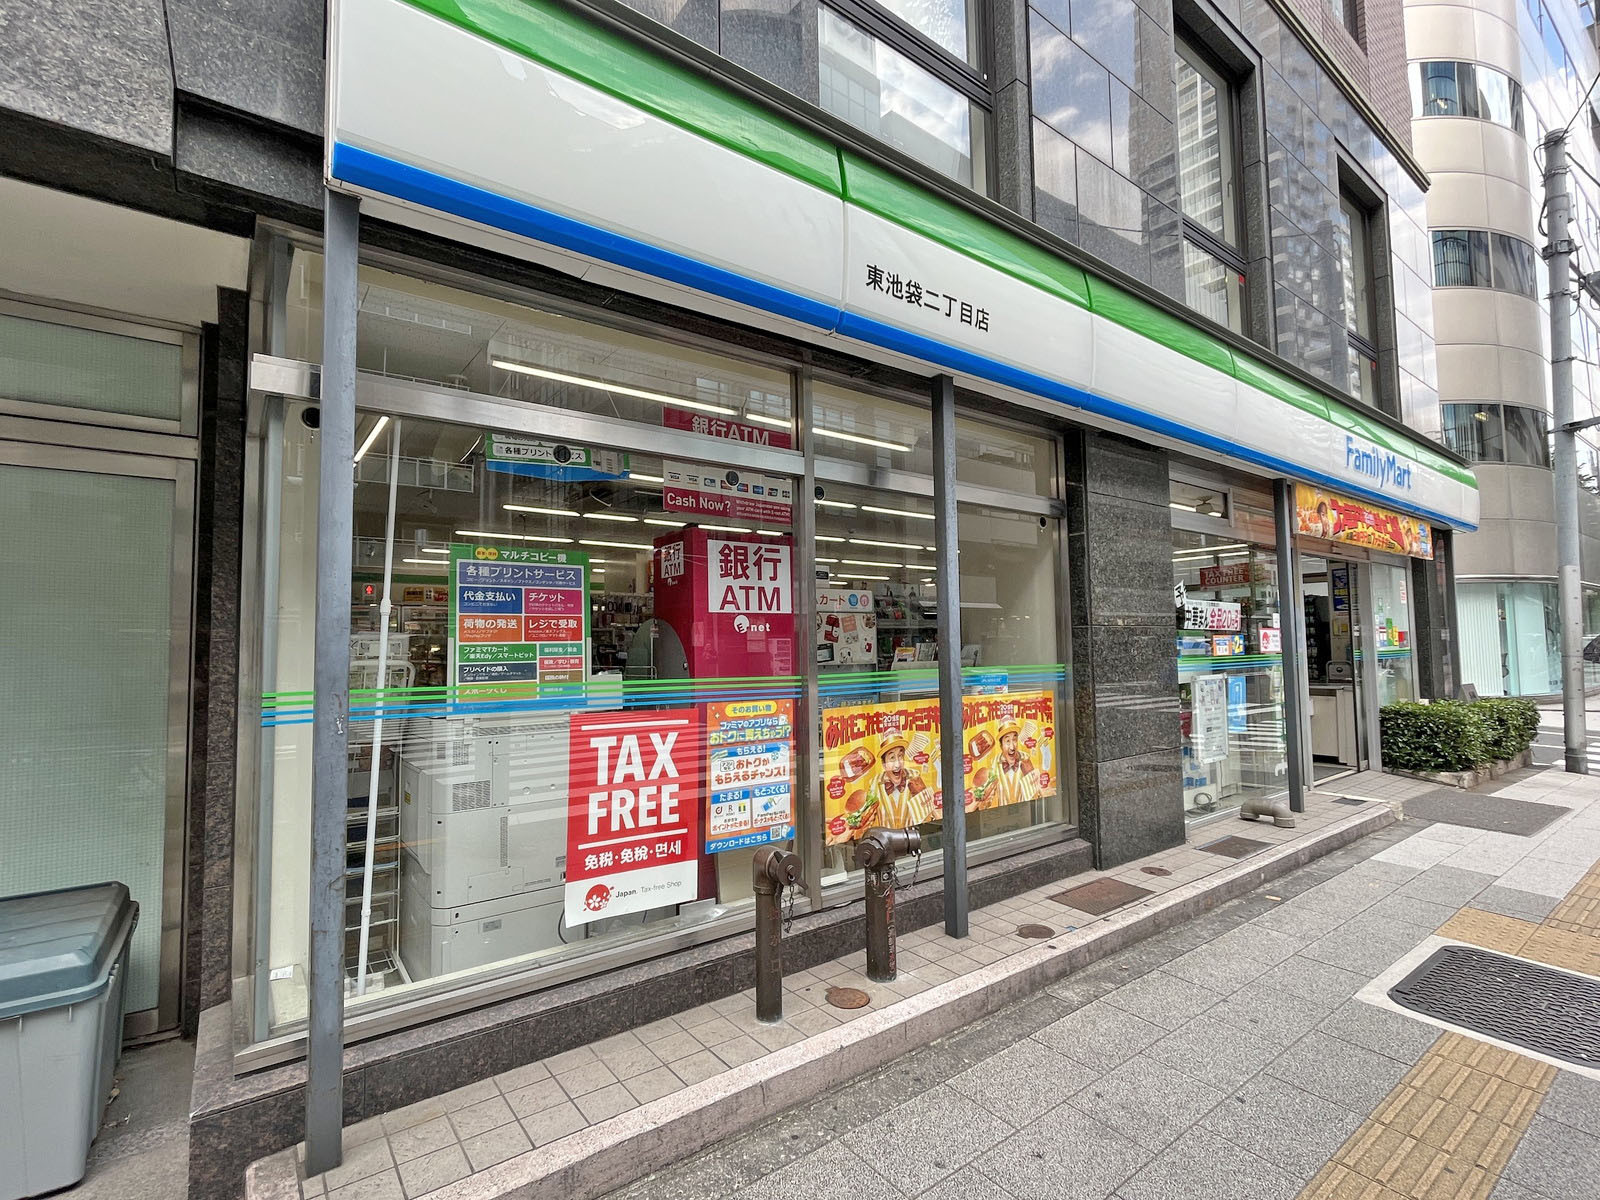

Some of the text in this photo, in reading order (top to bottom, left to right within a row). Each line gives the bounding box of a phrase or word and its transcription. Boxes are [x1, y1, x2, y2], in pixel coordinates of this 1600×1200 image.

[866, 264, 989, 333] 東池袋二丁目店
[692, 415, 769, 446] 銀行ATM
[505, 446, 583, 460] 各種プリントス
[1345, 435, 1411, 490] FamilyMart
[667, 492, 731, 512] Cash Now?
[500, 550, 567, 563] マルチコピー機
[718, 543, 782, 581] 銀行
[466, 565, 576, 580] 各種プリントサービス
[664, 562, 681, 577] ATM
[1223, 568, 1244, 576] FREE
[1205, 575, 1244, 584] COUNTER
[463, 591, 516, 601] 代金支払い
[529, 592, 565, 602] チケット
[719, 585, 781, 611] ATM
[816, 593, 846, 605] カード
[463, 618, 518, 629] 荷物の発送
[529, 618, 578, 629] レジで受取
[720, 717, 778, 730] ファミマのアプリなら
[736, 744, 766, 755] もらえる!
[590, 732, 680, 785] TAX
[736, 758, 770, 770] おトクが
[715, 765, 786, 785] もらえるチャンス!
[720, 791, 743, 802] たまる!
[754, 783, 788, 797] もどってくる!
[588, 784, 680, 835] FREE
[710, 833, 768, 850] ダウンロードはこちら
[641, 884, 666, 893] Tax-free
[666, 880, 682, 889] Shop
